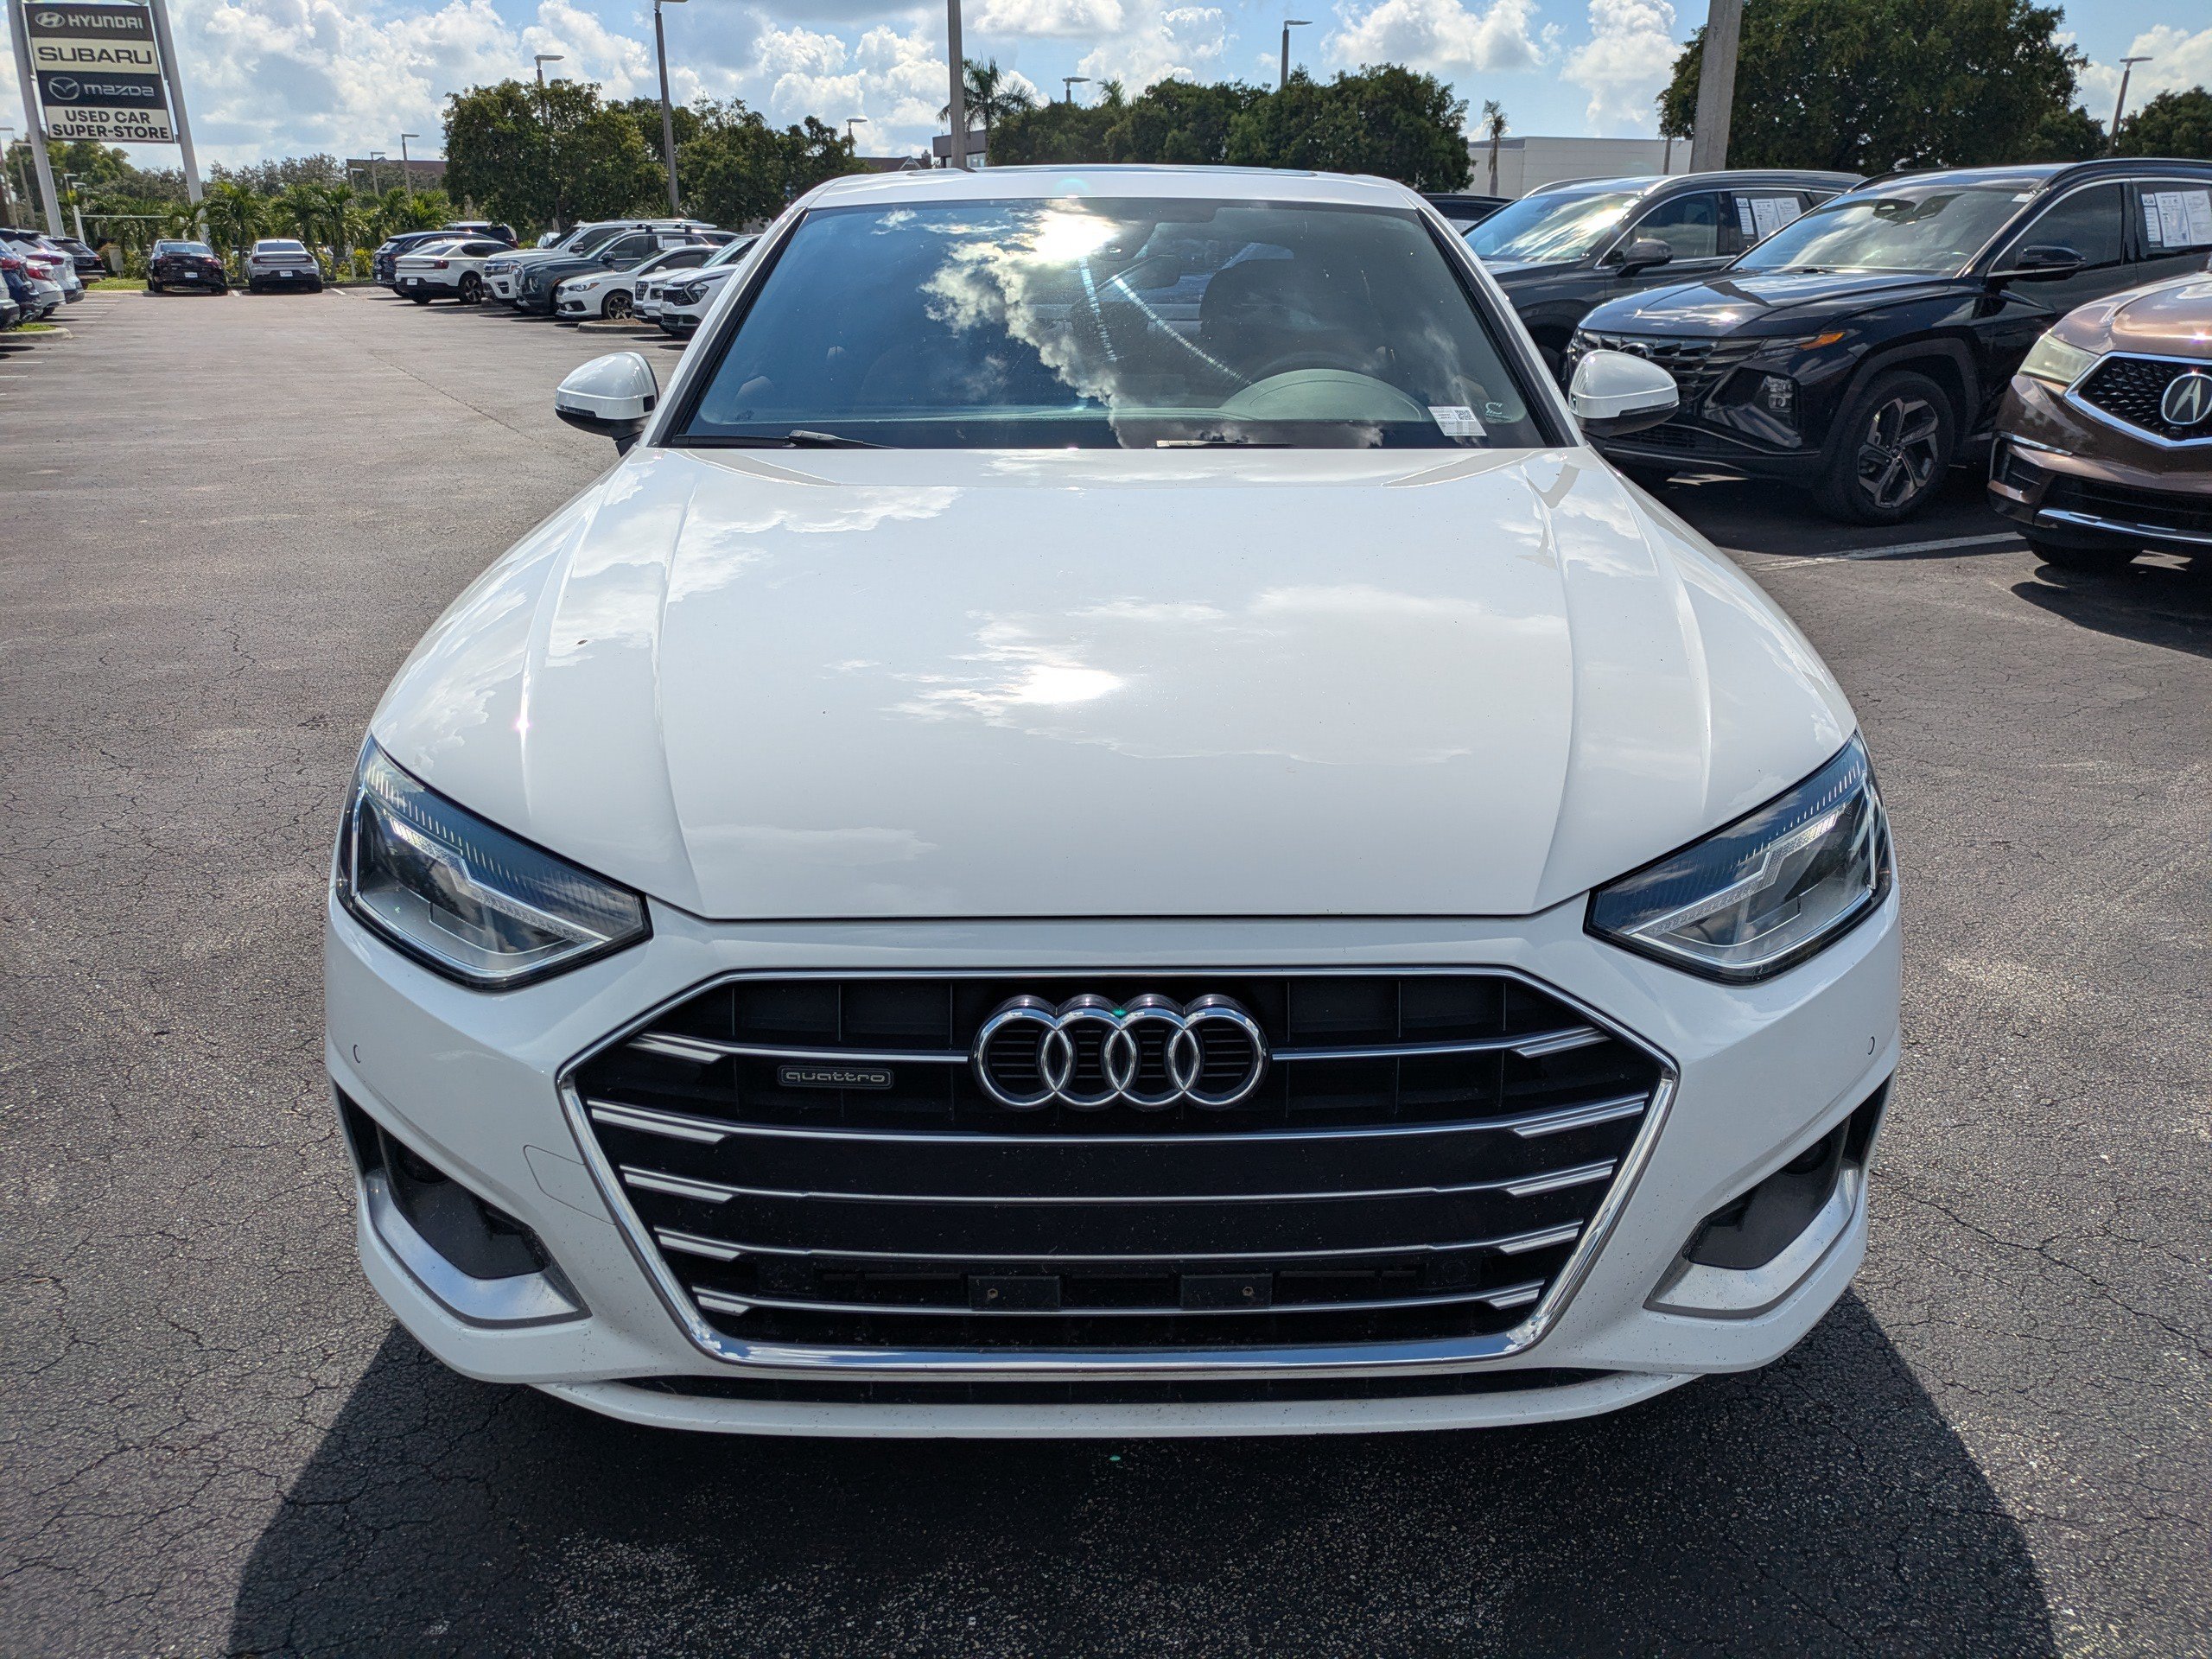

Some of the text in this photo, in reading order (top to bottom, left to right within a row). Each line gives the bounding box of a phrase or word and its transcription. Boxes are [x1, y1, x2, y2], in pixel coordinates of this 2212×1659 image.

[68, 14, 143, 29] HYUNDAI
[38, 47, 152, 65] SUBARU
[84, 84, 155, 97] mazda
[65, 110, 151, 124] USED CAR
[52, 124, 169, 139] SUPER-STORE
[785, 1071, 886, 1083] quattro
